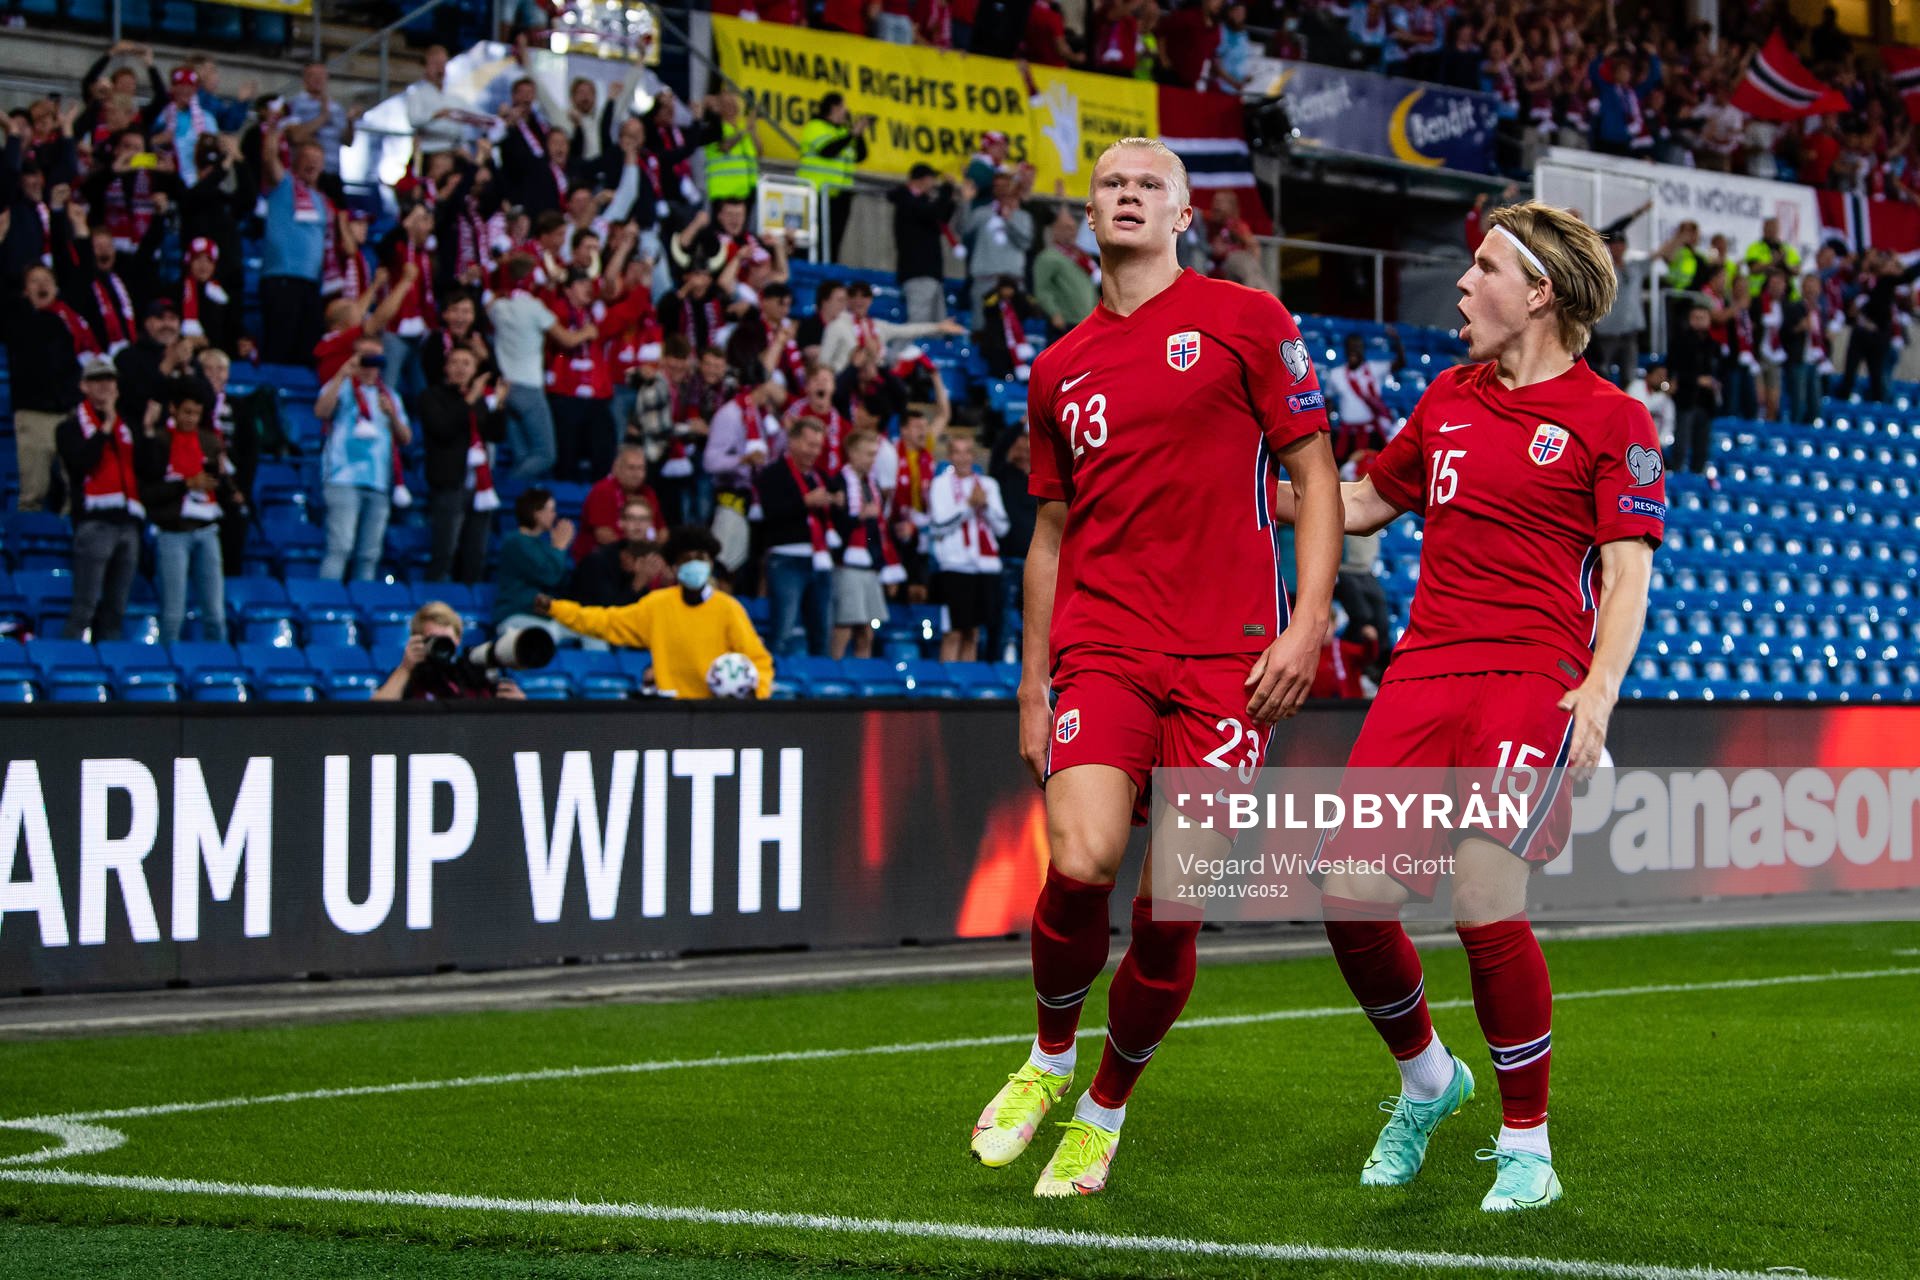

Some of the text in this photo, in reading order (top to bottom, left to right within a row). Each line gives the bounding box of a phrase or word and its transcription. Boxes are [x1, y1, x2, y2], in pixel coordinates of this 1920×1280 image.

[738, 38, 1024, 115] HUMAN RIGHTS FOR
[744, 86, 1027, 163] MIGT WORKS
[1061, 393, 1108, 459] 23
[1429, 450, 1467, 507] 15
[1634, 501, 1666, 517] RESPECT
[1203, 717, 1260, 785] 23
[1491, 740, 1546, 799] 15
[323, 752, 479, 934] UP
[514, 747, 803, 923] WITH
